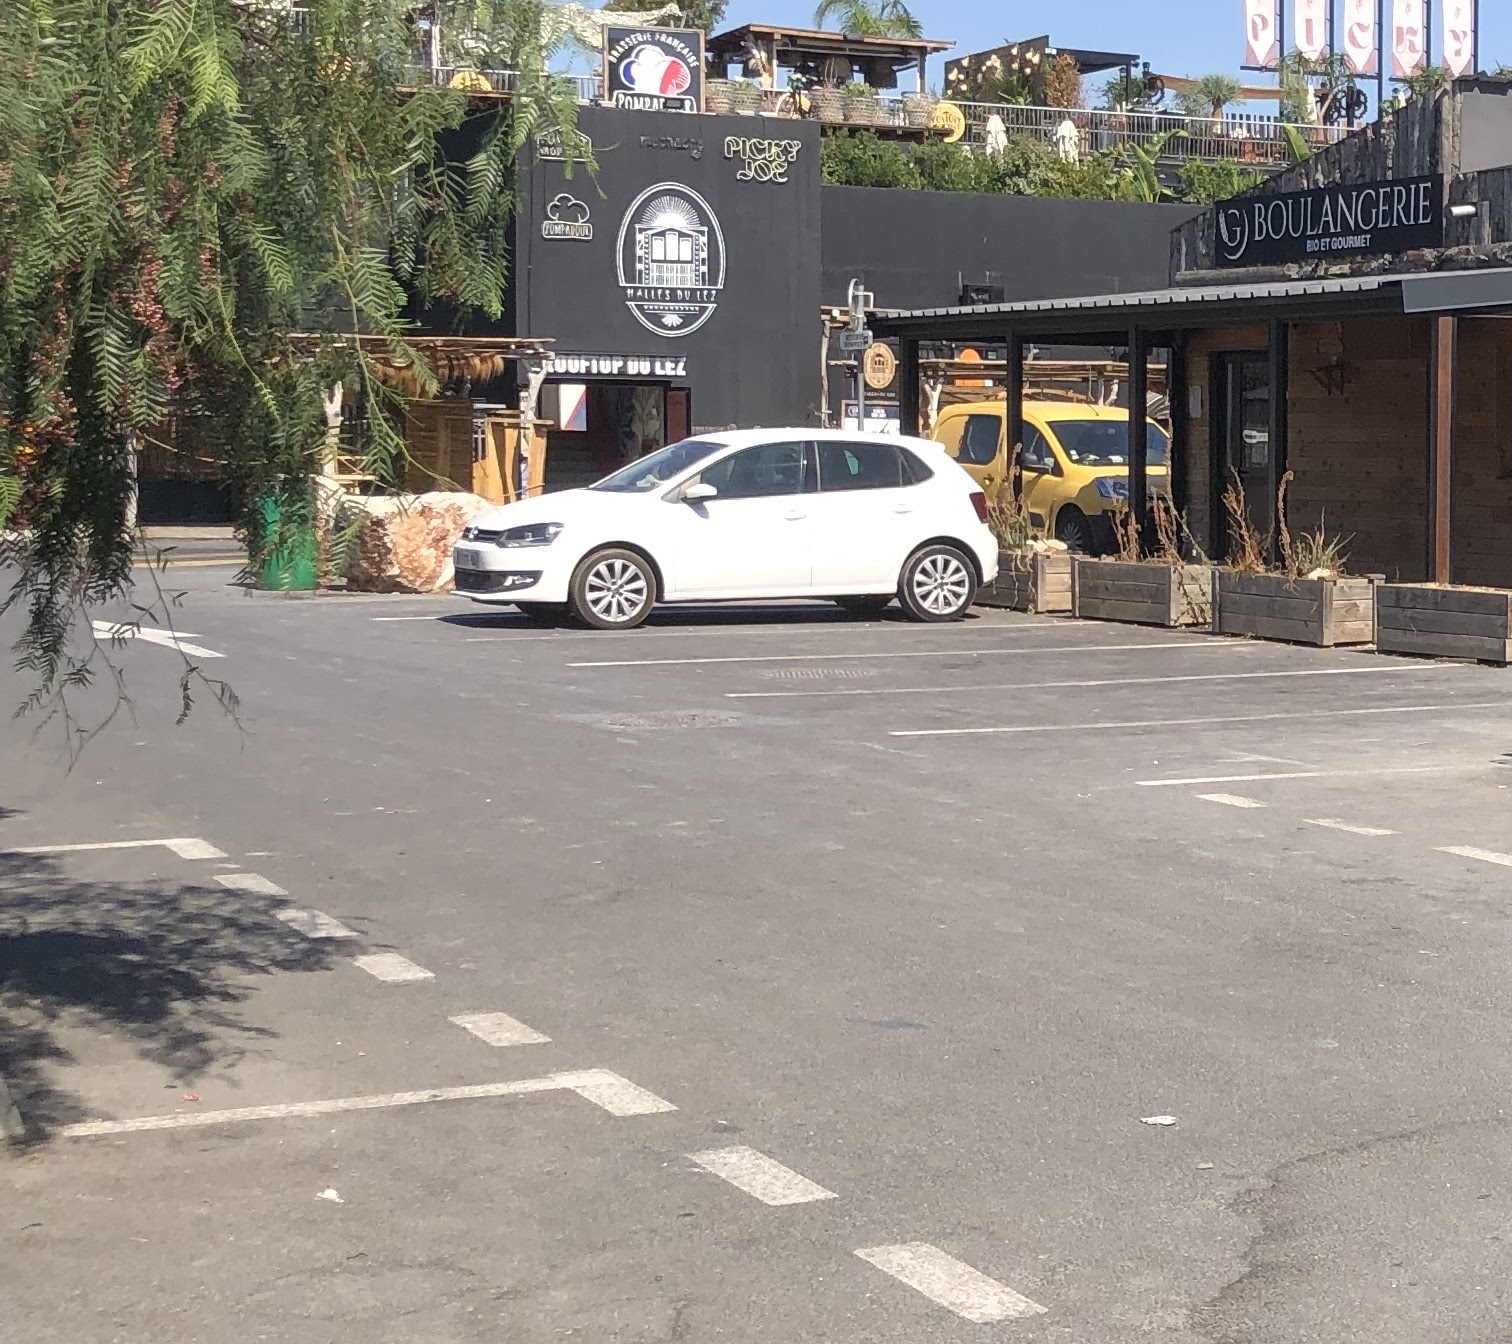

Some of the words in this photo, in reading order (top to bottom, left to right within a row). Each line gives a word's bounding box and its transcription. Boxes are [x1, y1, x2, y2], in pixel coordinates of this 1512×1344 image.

[1251, 13, 1468, 57] PICKY
[608, 32, 652, 63] BRASSERIE
[655, 32, 699, 67] FRANÇAISE
[725, 136, 801, 161] PICKY
[737, 159, 788, 182] JOE
[1253, 182, 1433, 241] BOULANGERIE
[1306, 239, 1319, 252] BIO
[1320, 237, 1330, 251] ET
[1331, 234, 1371, 250] GOURMET
[626, 288, 671, 300] HALLES
[676, 289, 690, 300] DU
[697, 290, 717, 301] LEZ
[626, 356, 650, 375] DU
[654, 357, 687, 376] LEZ
